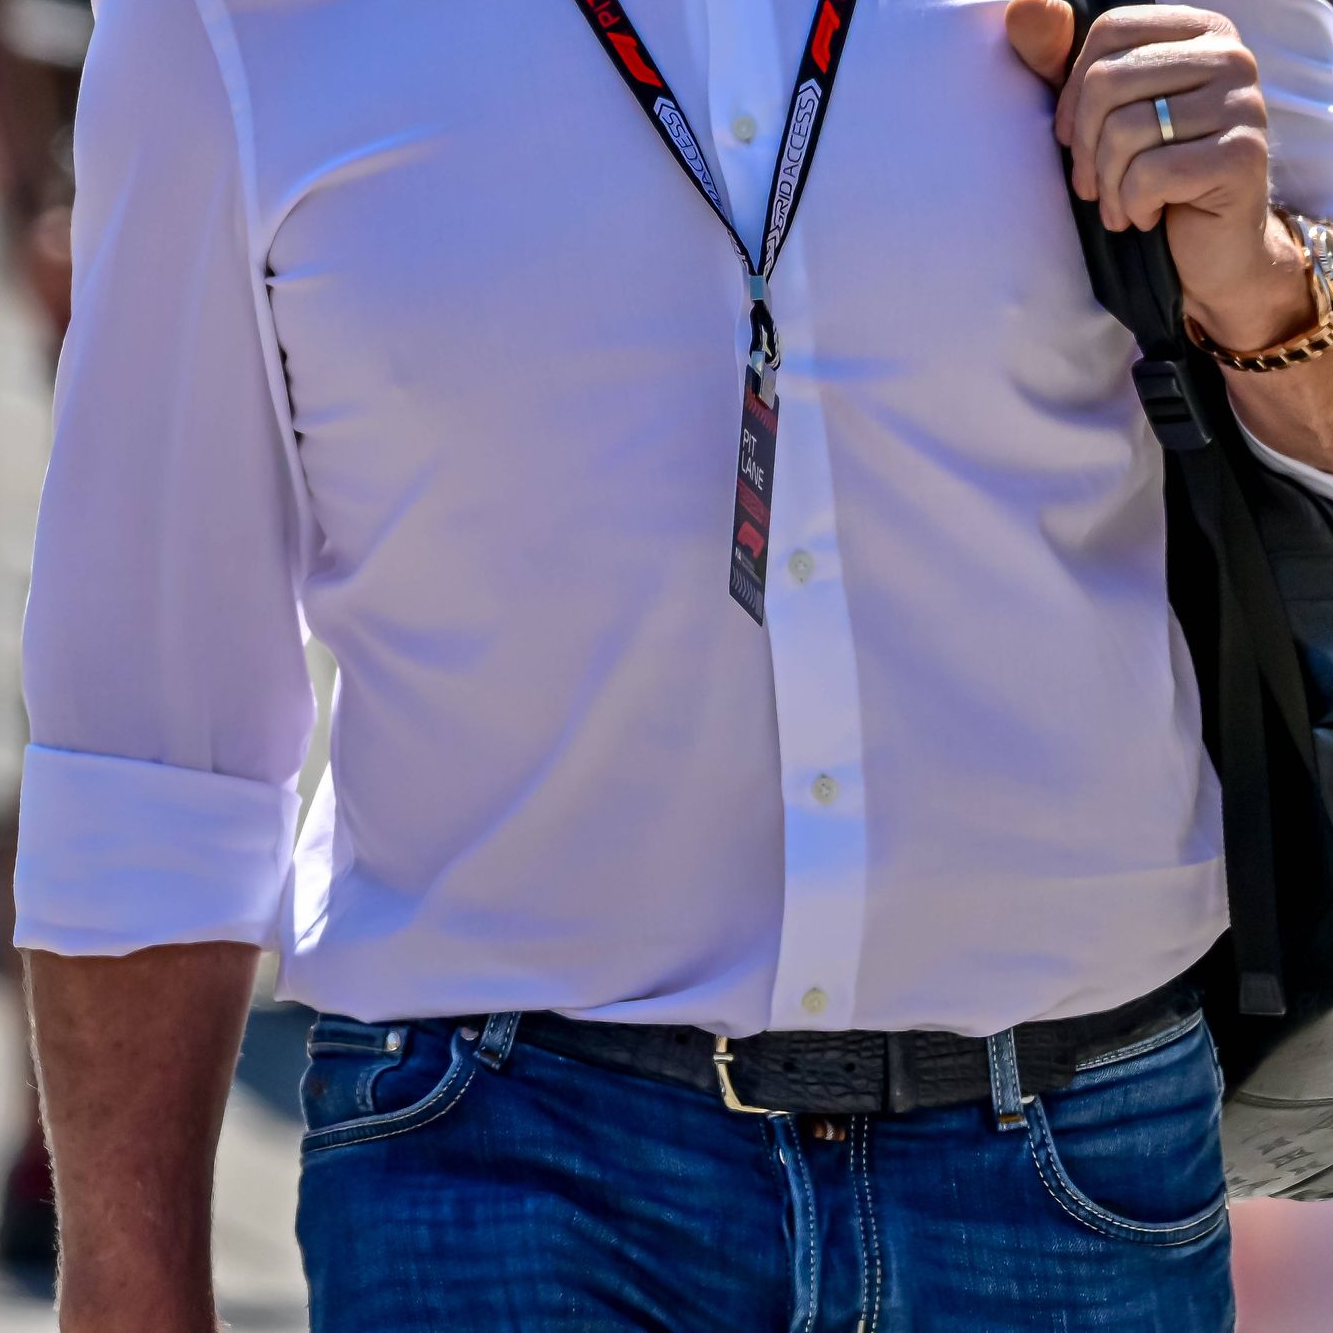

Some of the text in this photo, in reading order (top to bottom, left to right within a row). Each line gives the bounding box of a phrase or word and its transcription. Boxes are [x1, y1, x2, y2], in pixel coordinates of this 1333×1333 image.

[662, 111, 712, 185] ACCESS
[773, 95, 816, 231] GRID ACCESS
[742, 428, 758, 457] PIT
[741, 452, 765, 491] LANE
